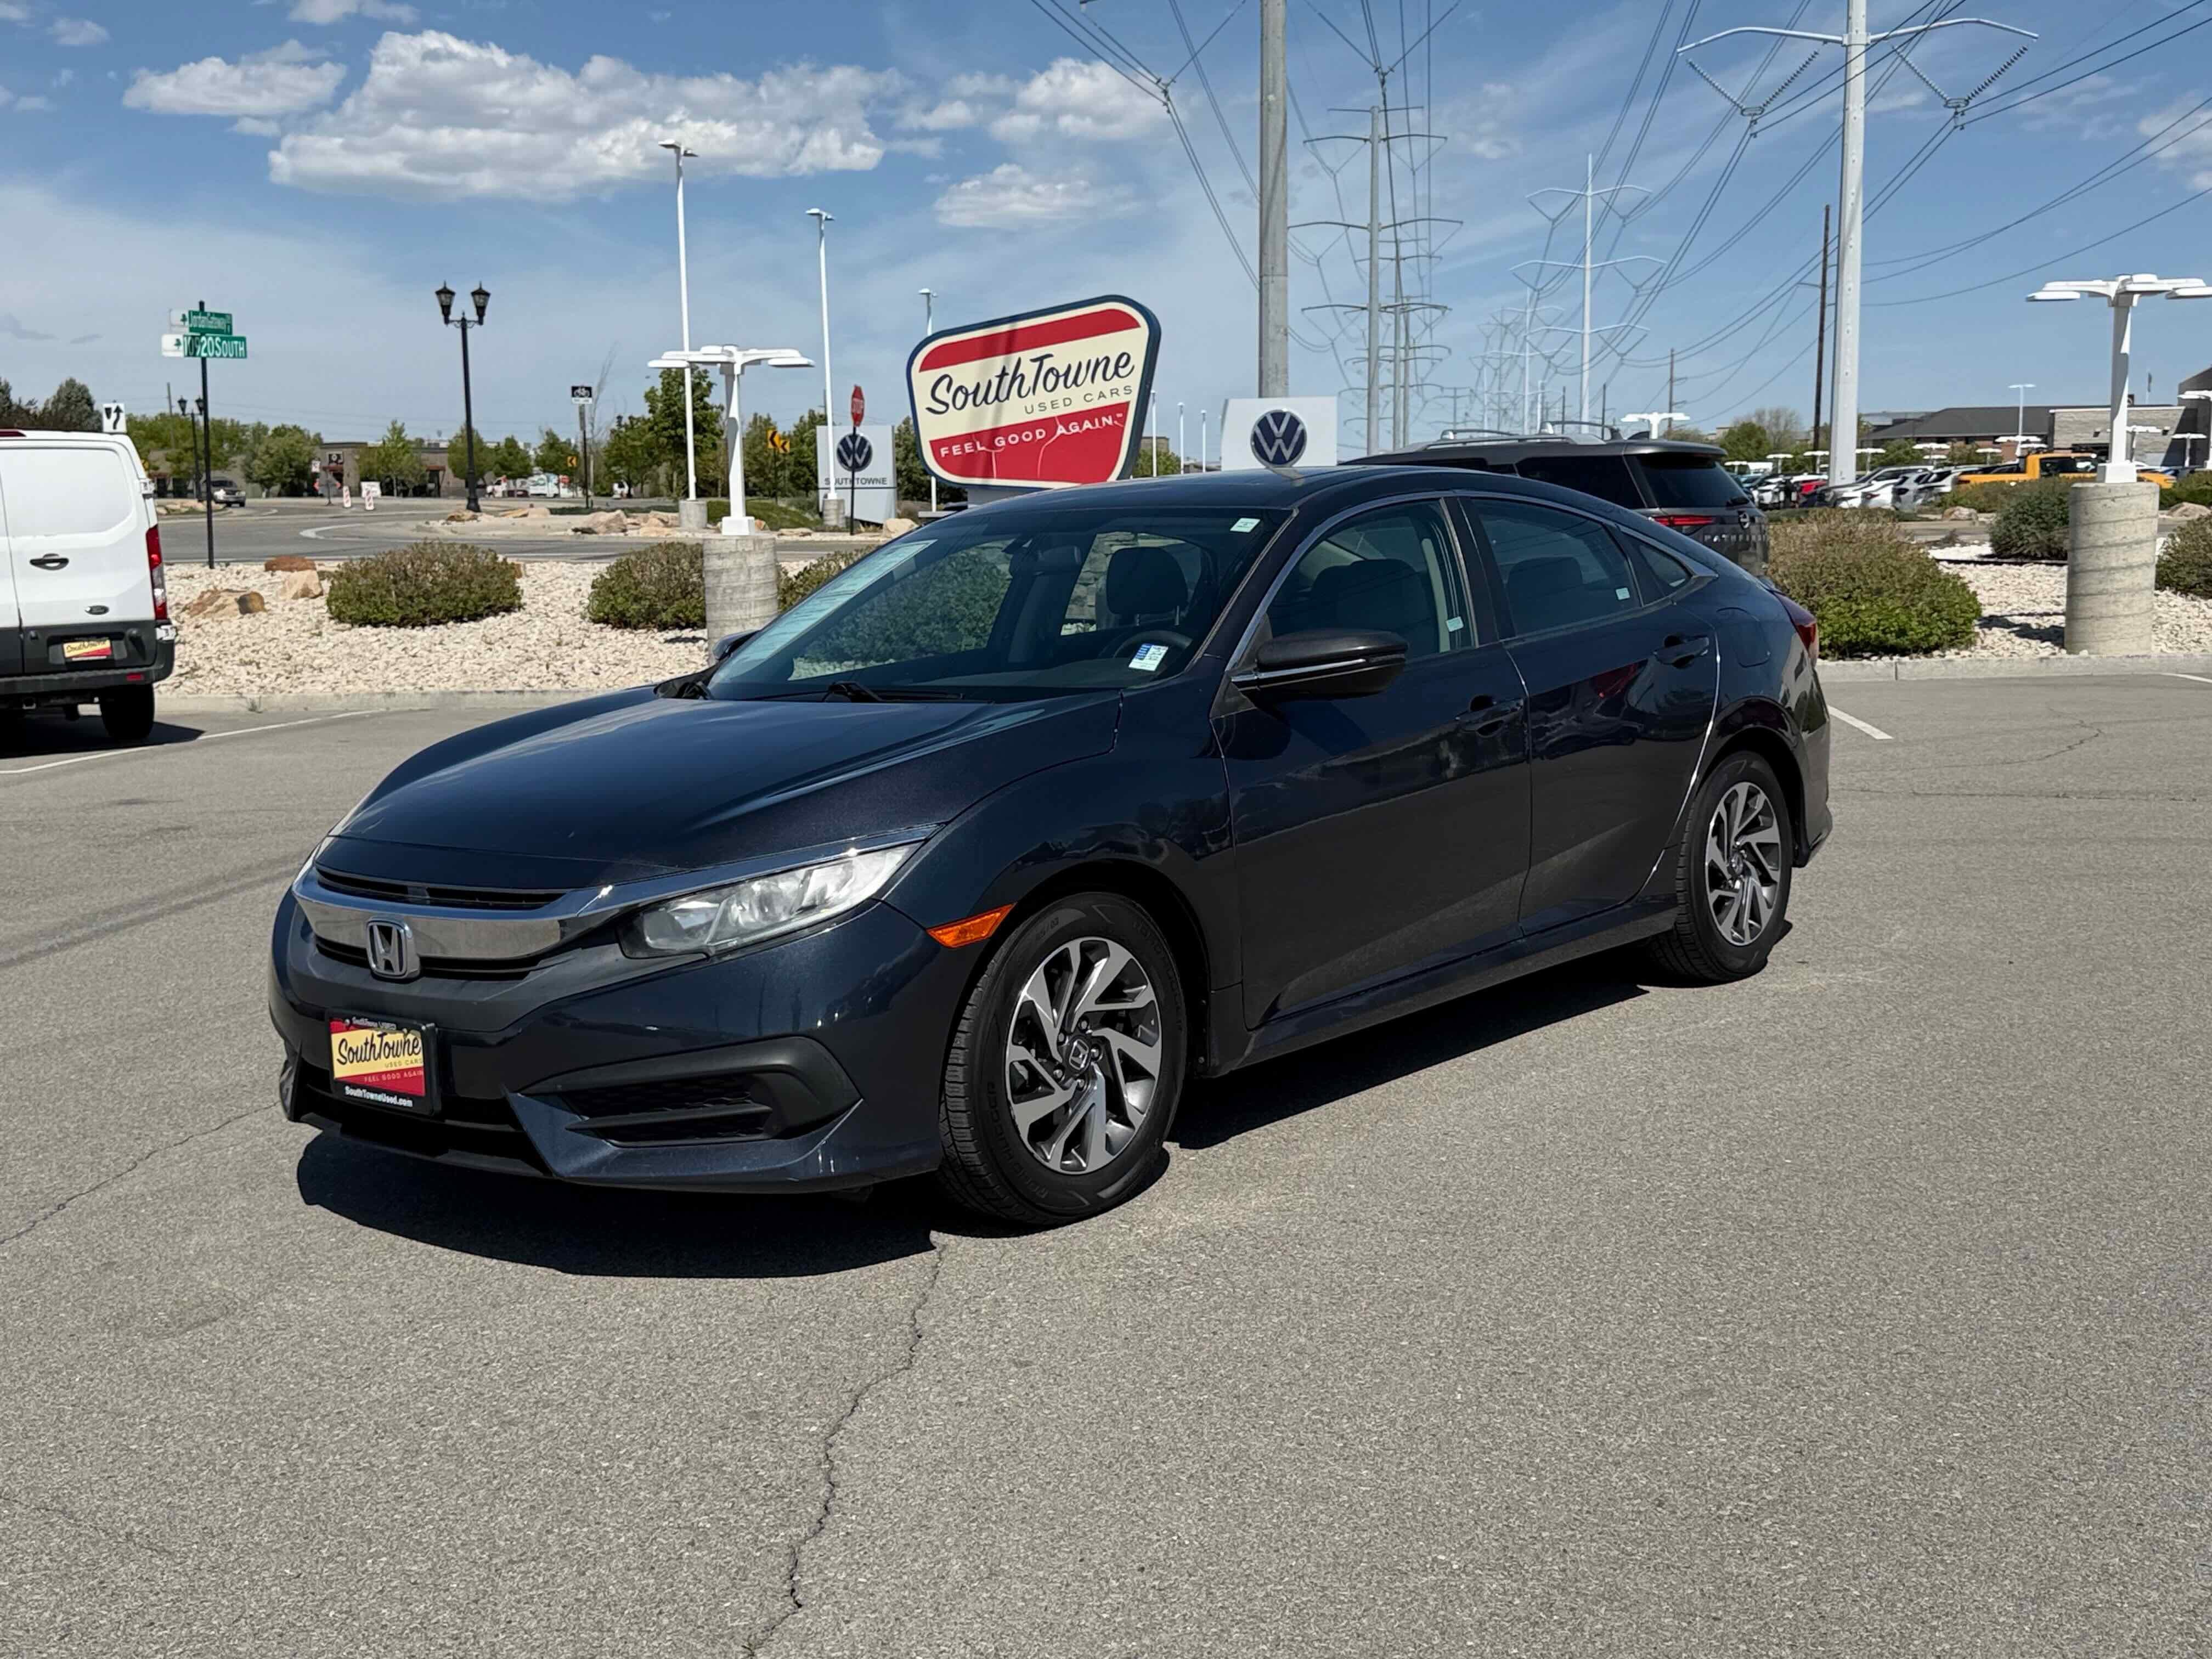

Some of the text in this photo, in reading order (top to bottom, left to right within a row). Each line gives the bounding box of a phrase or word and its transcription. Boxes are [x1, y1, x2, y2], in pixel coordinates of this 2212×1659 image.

[926, 351, 1135, 415] SouthTowne
[1024, 385, 1133, 415] USED CARS
[939, 441, 985, 458] FEEL
[994, 428, 1046, 448] GOOD
[337, 1031, 422, 1065] SouthTowne
[345, 1085, 413, 1108] SouthTowneUsed.com
